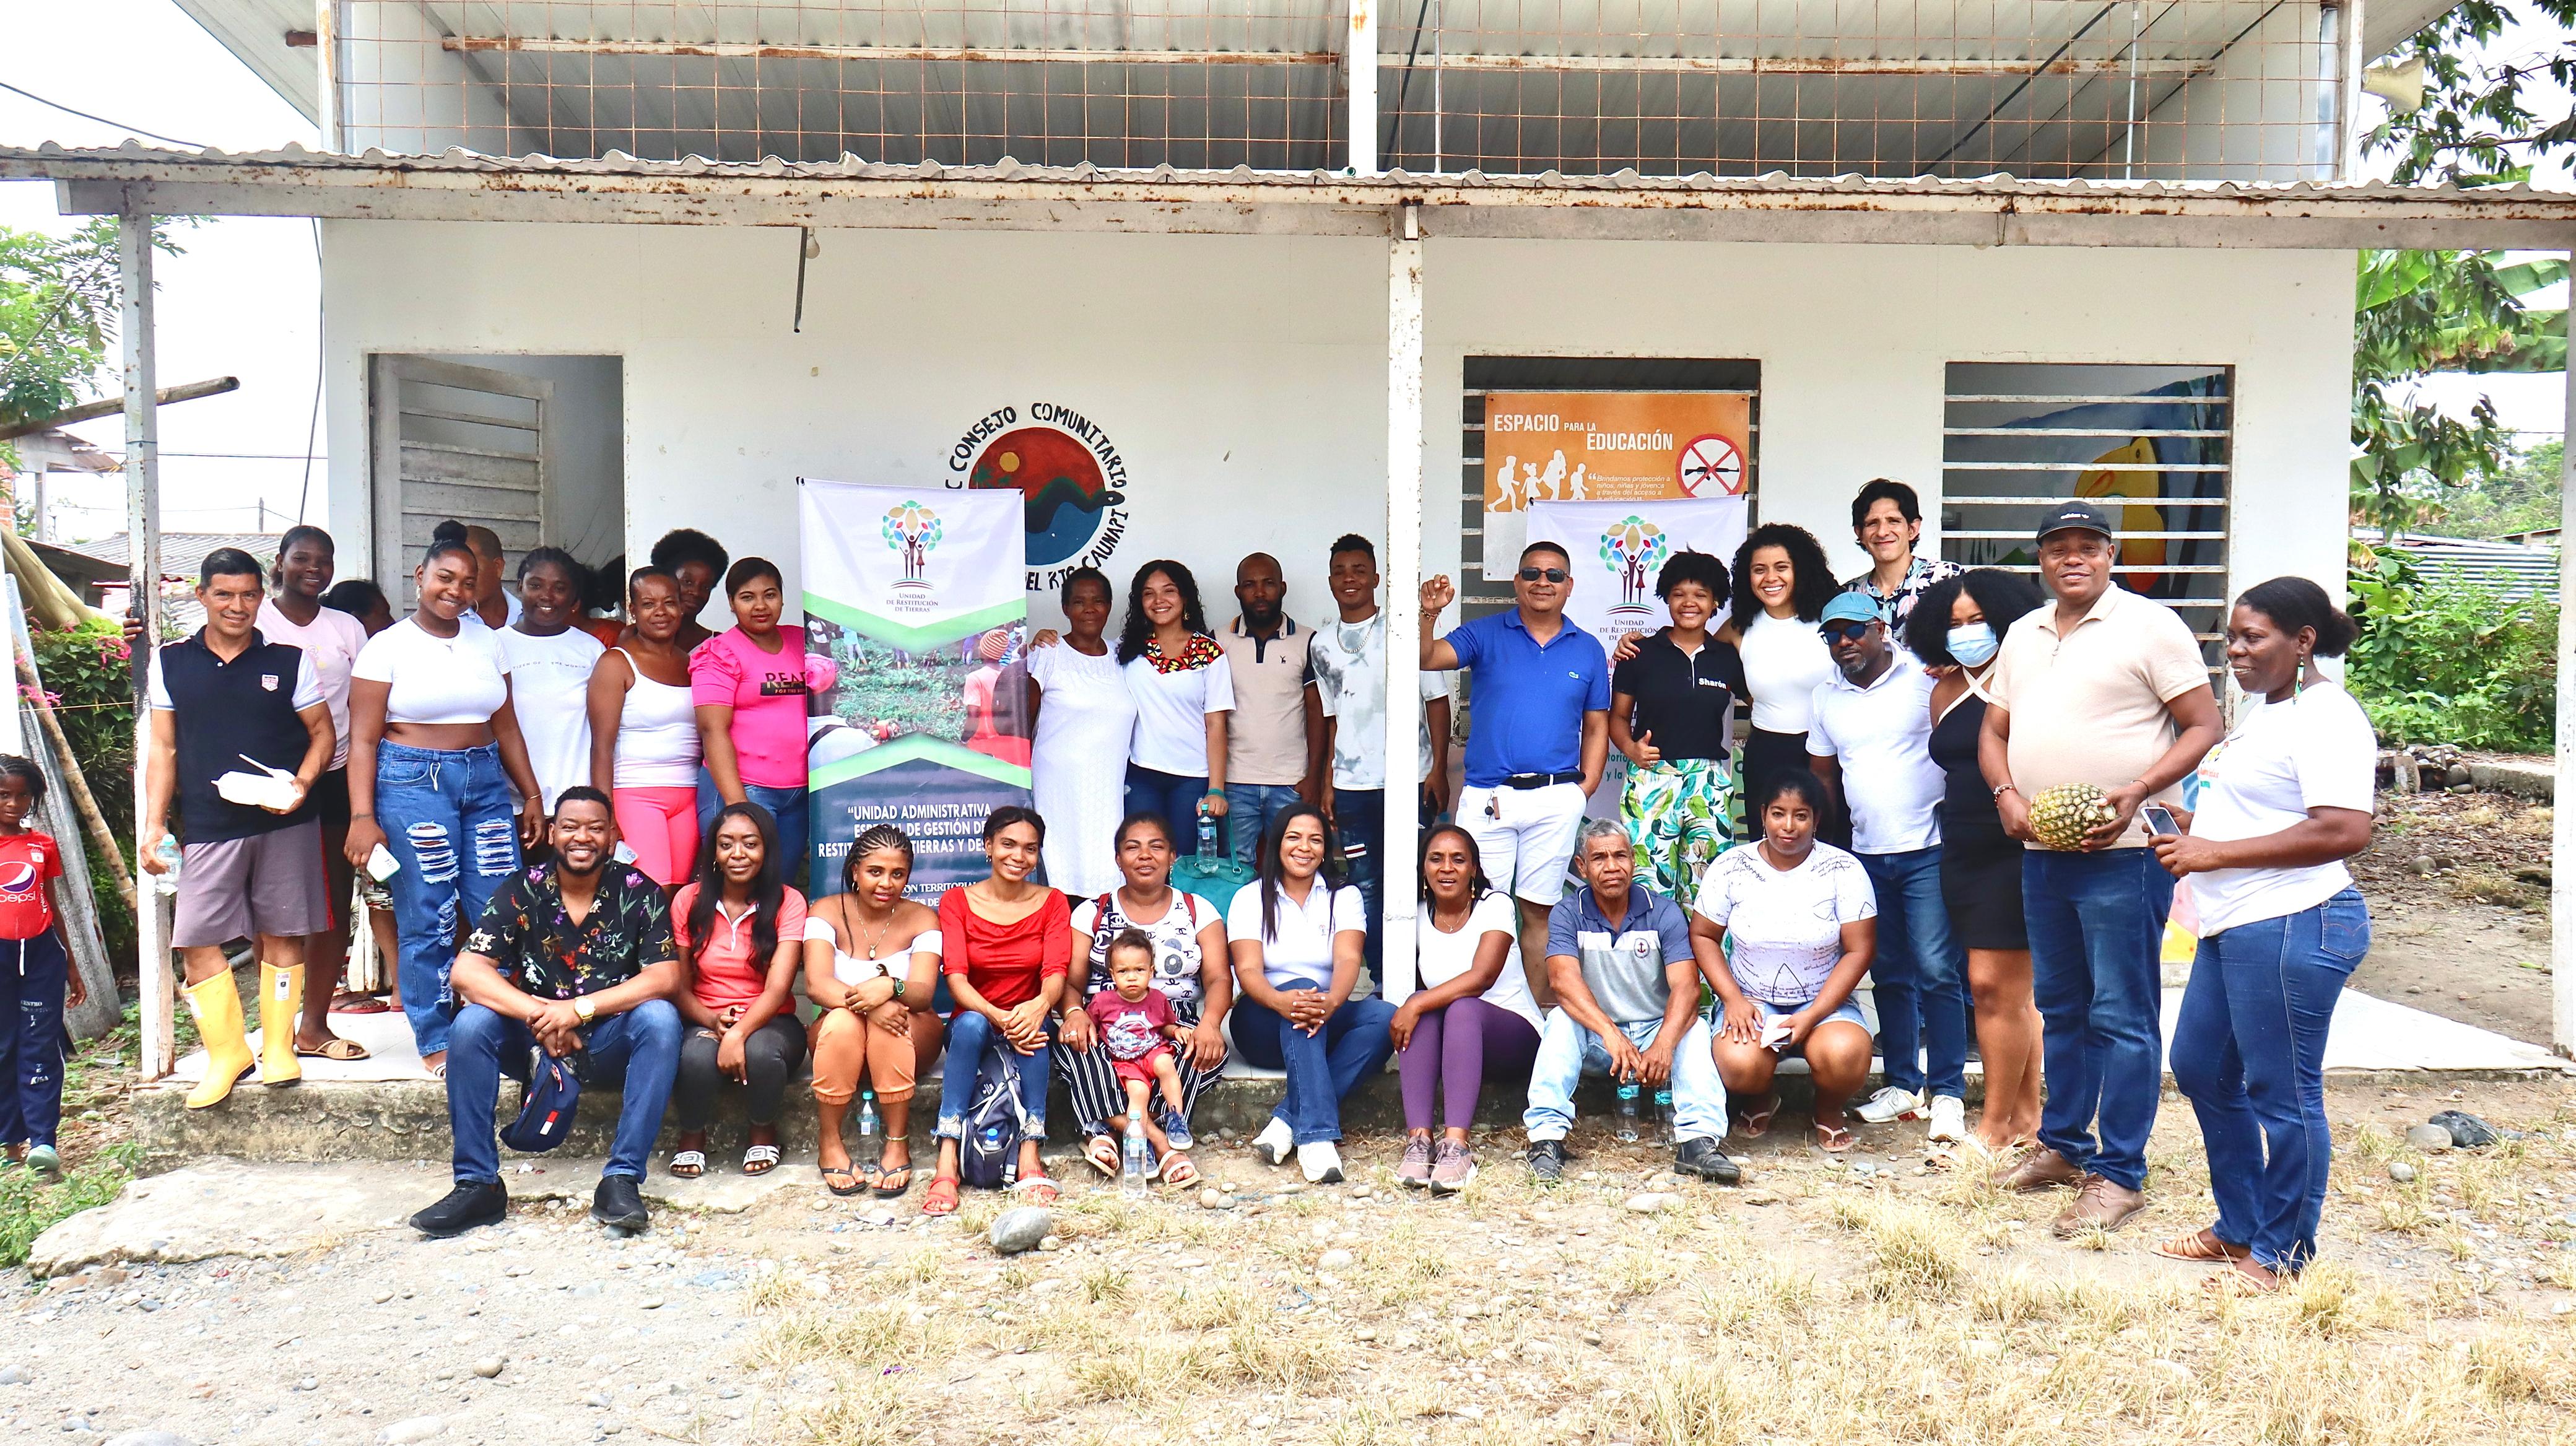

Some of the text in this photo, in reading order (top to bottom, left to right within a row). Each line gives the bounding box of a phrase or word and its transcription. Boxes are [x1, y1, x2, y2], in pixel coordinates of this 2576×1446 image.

[1494, 414, 1596, 432] ESPACIO PARA LA
[949, 406, 1017, 472] CONSEJO
[1031, 403, 1127, 488] COMUNITARIO
[1586, 429, 1673, 451] EDUCACIÓN
[1025, 571, 1042, 591] EL
[1081, 508, 1129, 570] CAUNAPI
[1699, 677, 1726, 689] Sharón
[1608, 751, 1628, 762] torio
[1606, 768, 1622, 782] y la
[847, 803, 991, 821] “UNIDAD ADMINISTRATIVA
[907, 822, 921, 836] DE
[923, 818, 970, 836] GESTIÓN
[818, 838, 986, 858] RESTIT TIERRAS Y DES
